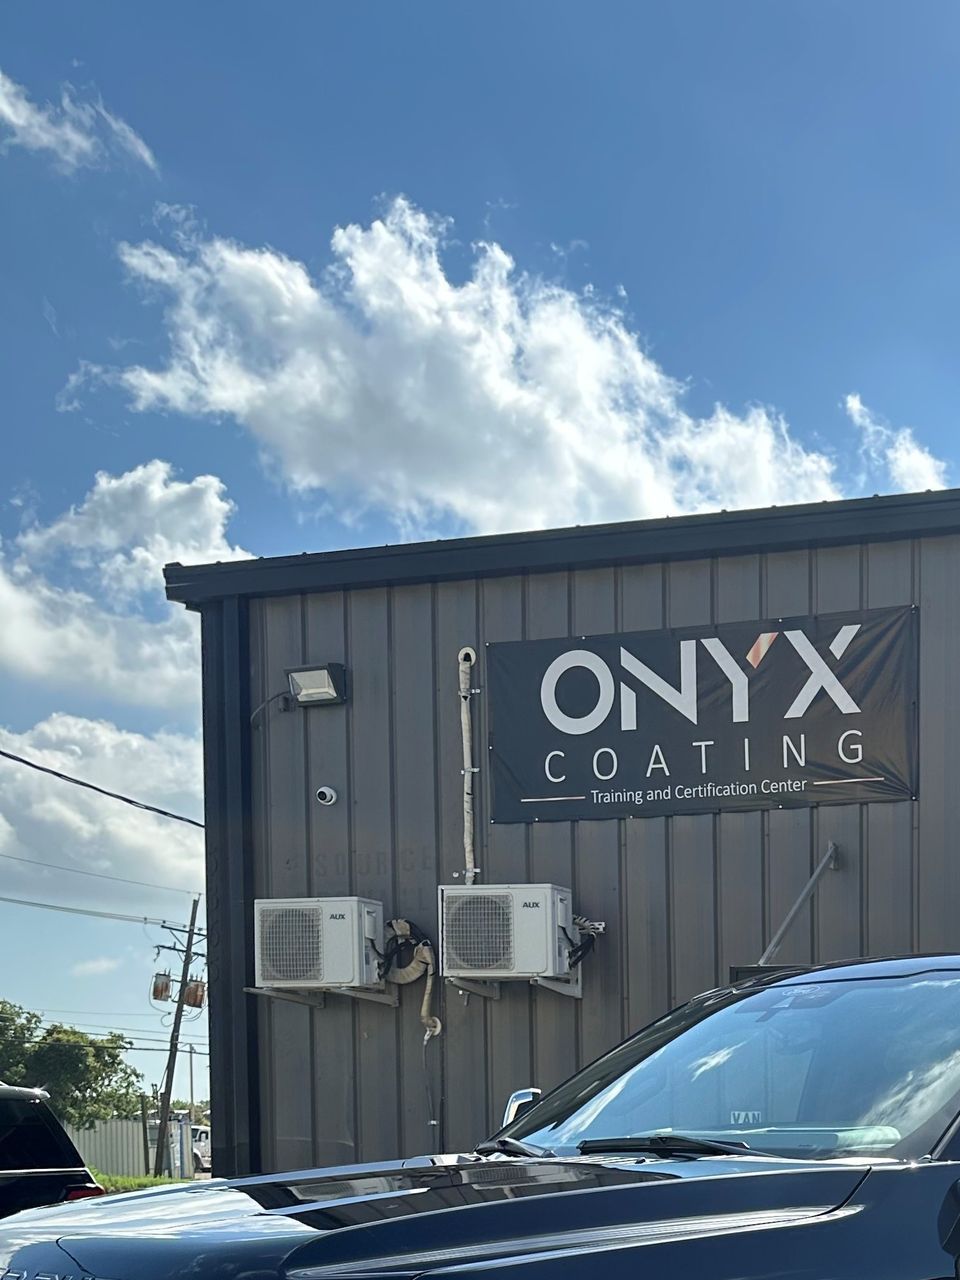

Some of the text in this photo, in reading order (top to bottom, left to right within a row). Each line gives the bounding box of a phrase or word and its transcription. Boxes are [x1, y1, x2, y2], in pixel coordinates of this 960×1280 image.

[540, 623, 862, 736] ONYX
[544, 729, 864, 784] COATING
[591, 779, 808, 804] Training and Certification Center
[329, 913, 346, 921] AUX
[522, 901, 541, 909] AUX
